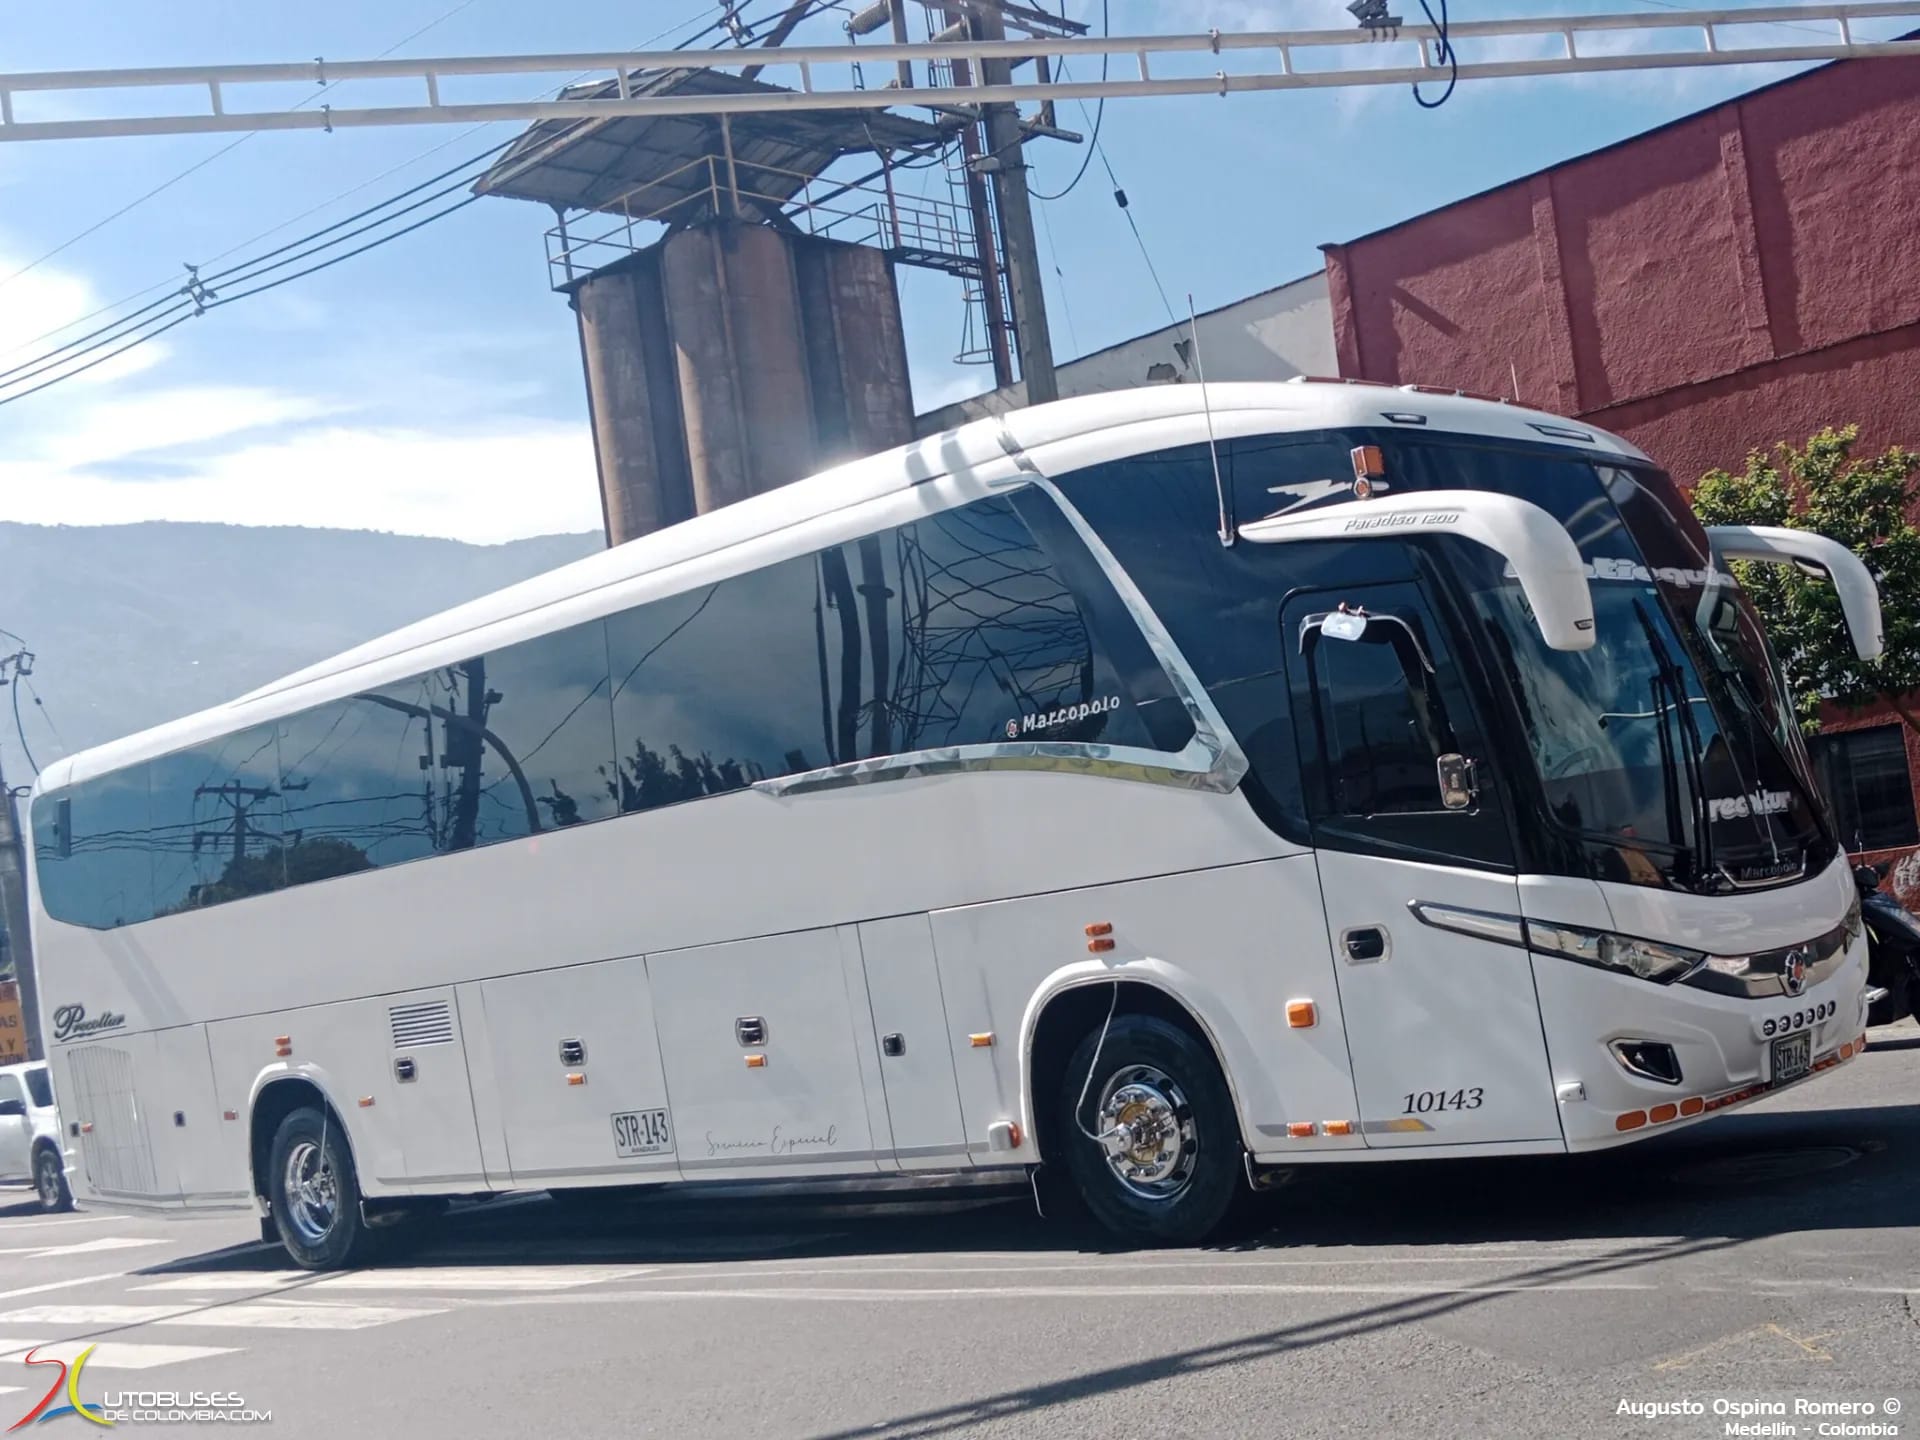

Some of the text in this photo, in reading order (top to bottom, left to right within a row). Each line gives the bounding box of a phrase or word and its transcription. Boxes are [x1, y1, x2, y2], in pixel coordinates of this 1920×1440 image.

[1344, 512, 1460, 531] Paradiso 1200
[1022, 696, 1121, 733] Marcopolo
[1402, 1087, 1484, 1114] 10143
